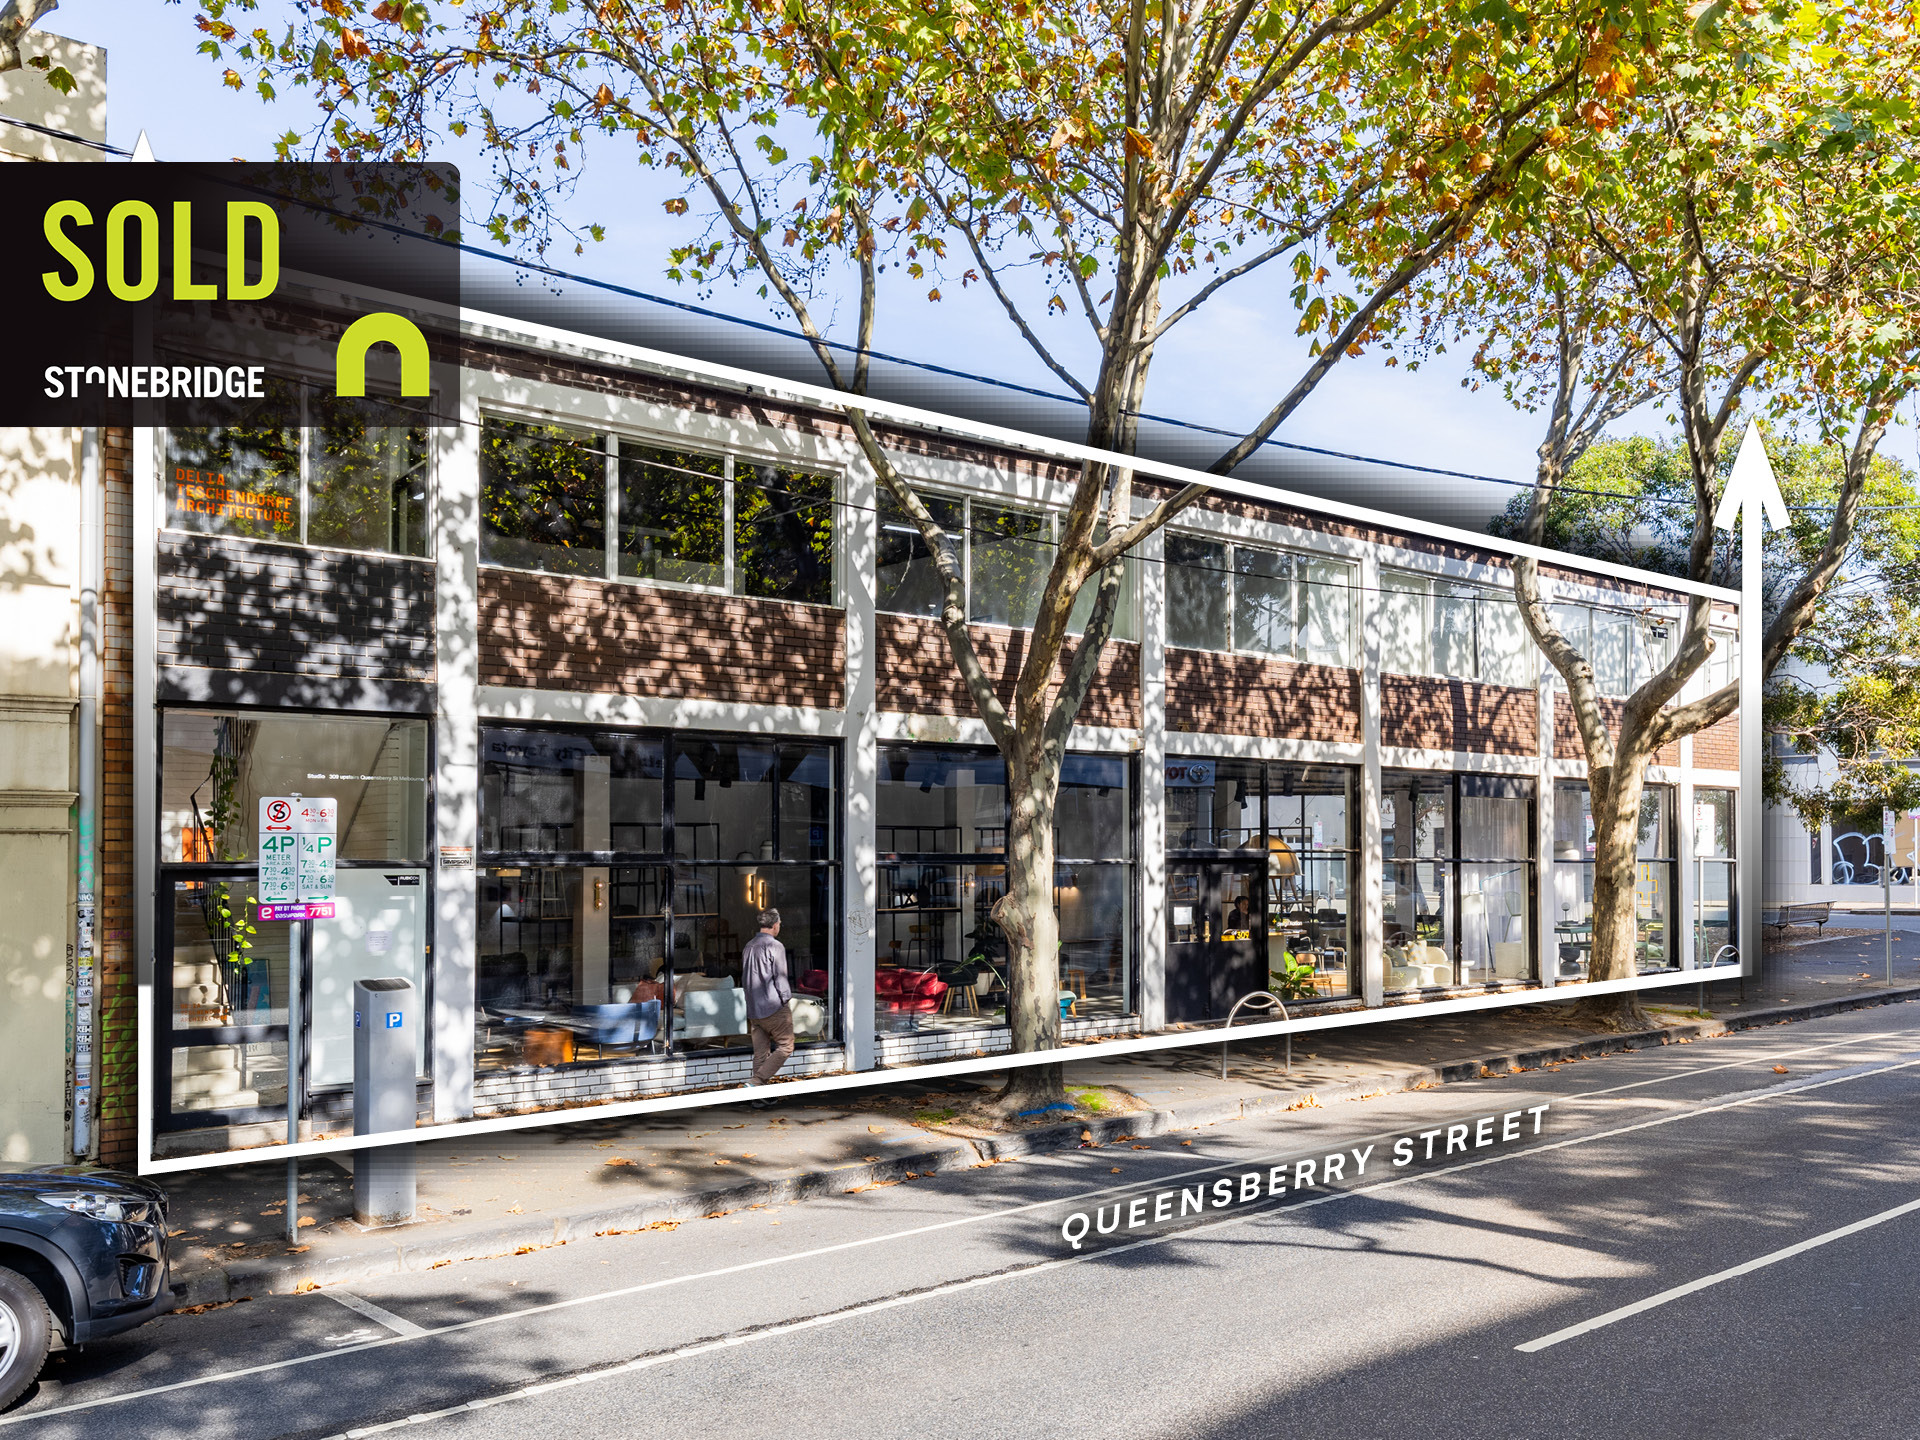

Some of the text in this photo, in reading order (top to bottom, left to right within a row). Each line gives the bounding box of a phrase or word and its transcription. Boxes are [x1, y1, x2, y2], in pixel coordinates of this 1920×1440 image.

[176, 468, 225, 486] DELIA
[176, 483, 293, 510] TESCHENDORFF
[176, 497, 291, 524] ARCHITECTURE
[262, 836, 295, 853] 4P
[308, 906, 332, 916] 7751
[1236, 930, 1250, 939] 309
